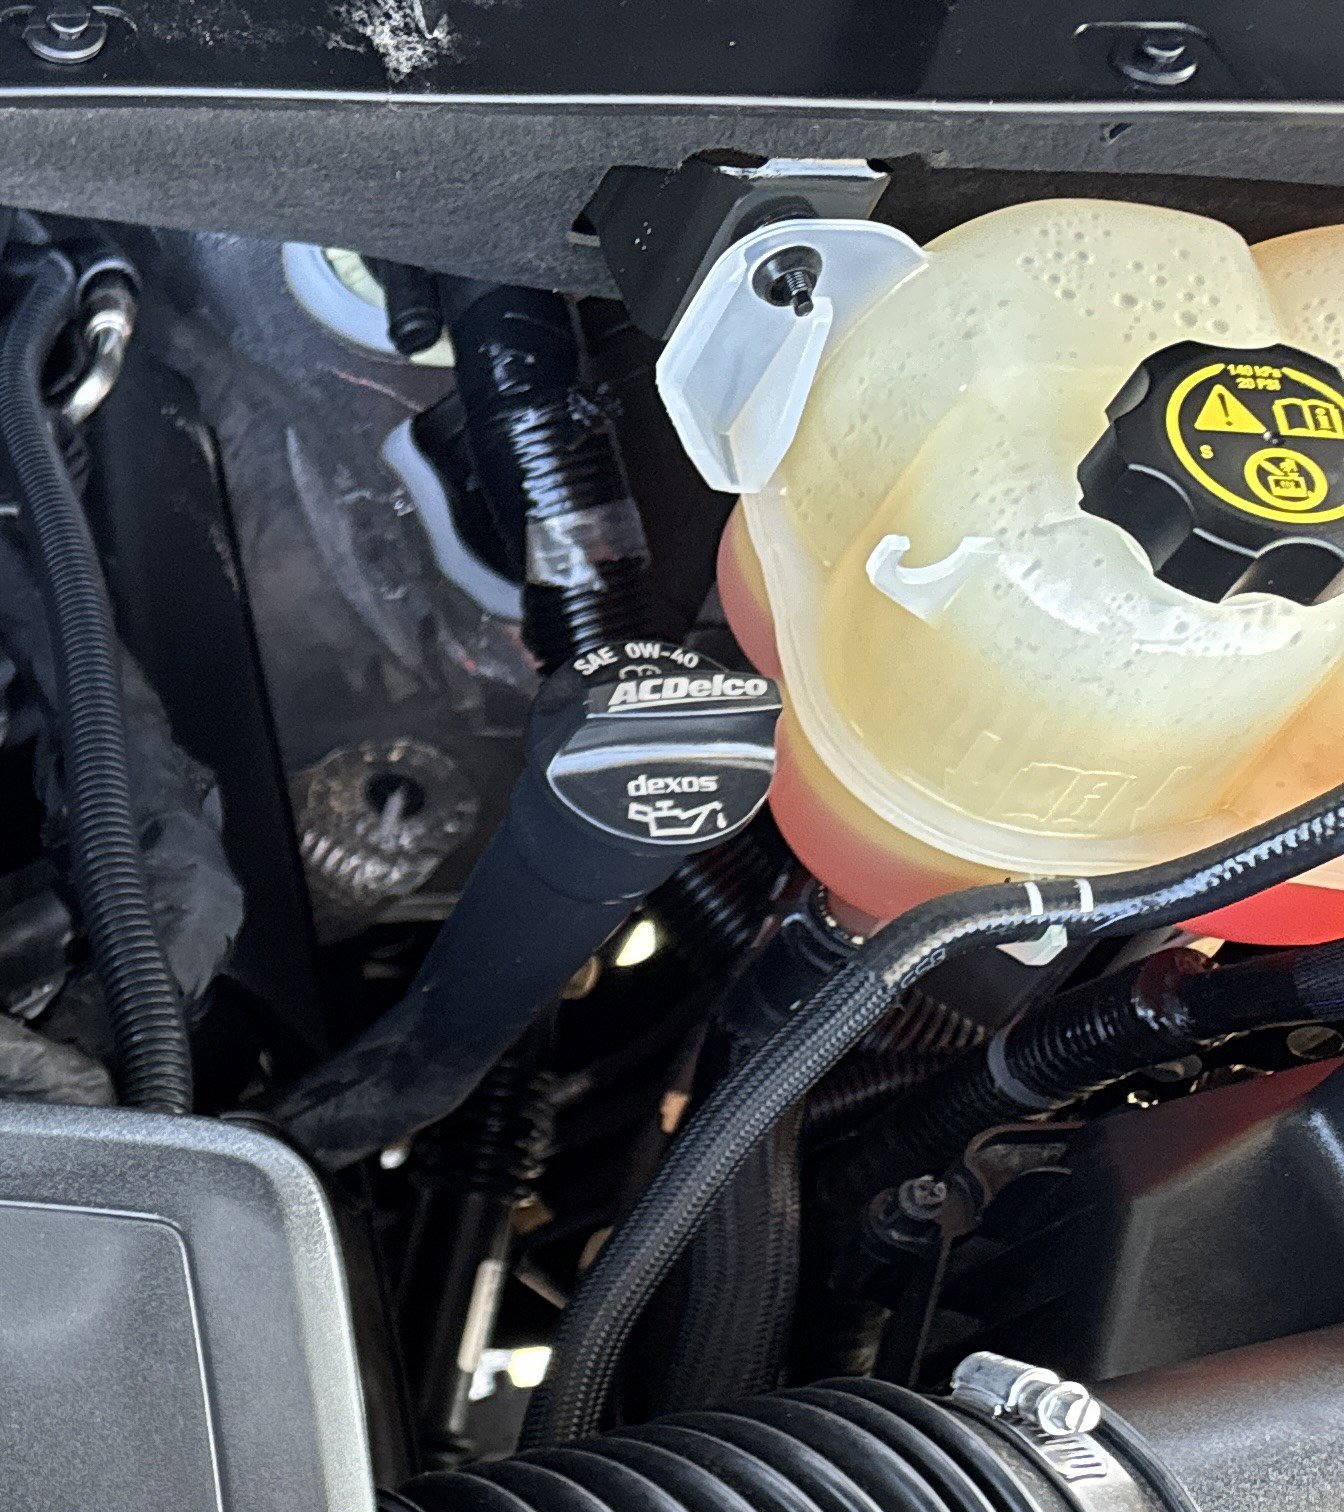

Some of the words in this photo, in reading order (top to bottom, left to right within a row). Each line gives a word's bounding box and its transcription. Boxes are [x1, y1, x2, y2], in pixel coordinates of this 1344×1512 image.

[573, 646, 618, 676] SAE
[624, 642, 699, 669] 0W-40
[608, 674, 768, 706] ACDelco
[627, 774, 719, 797] dexos
